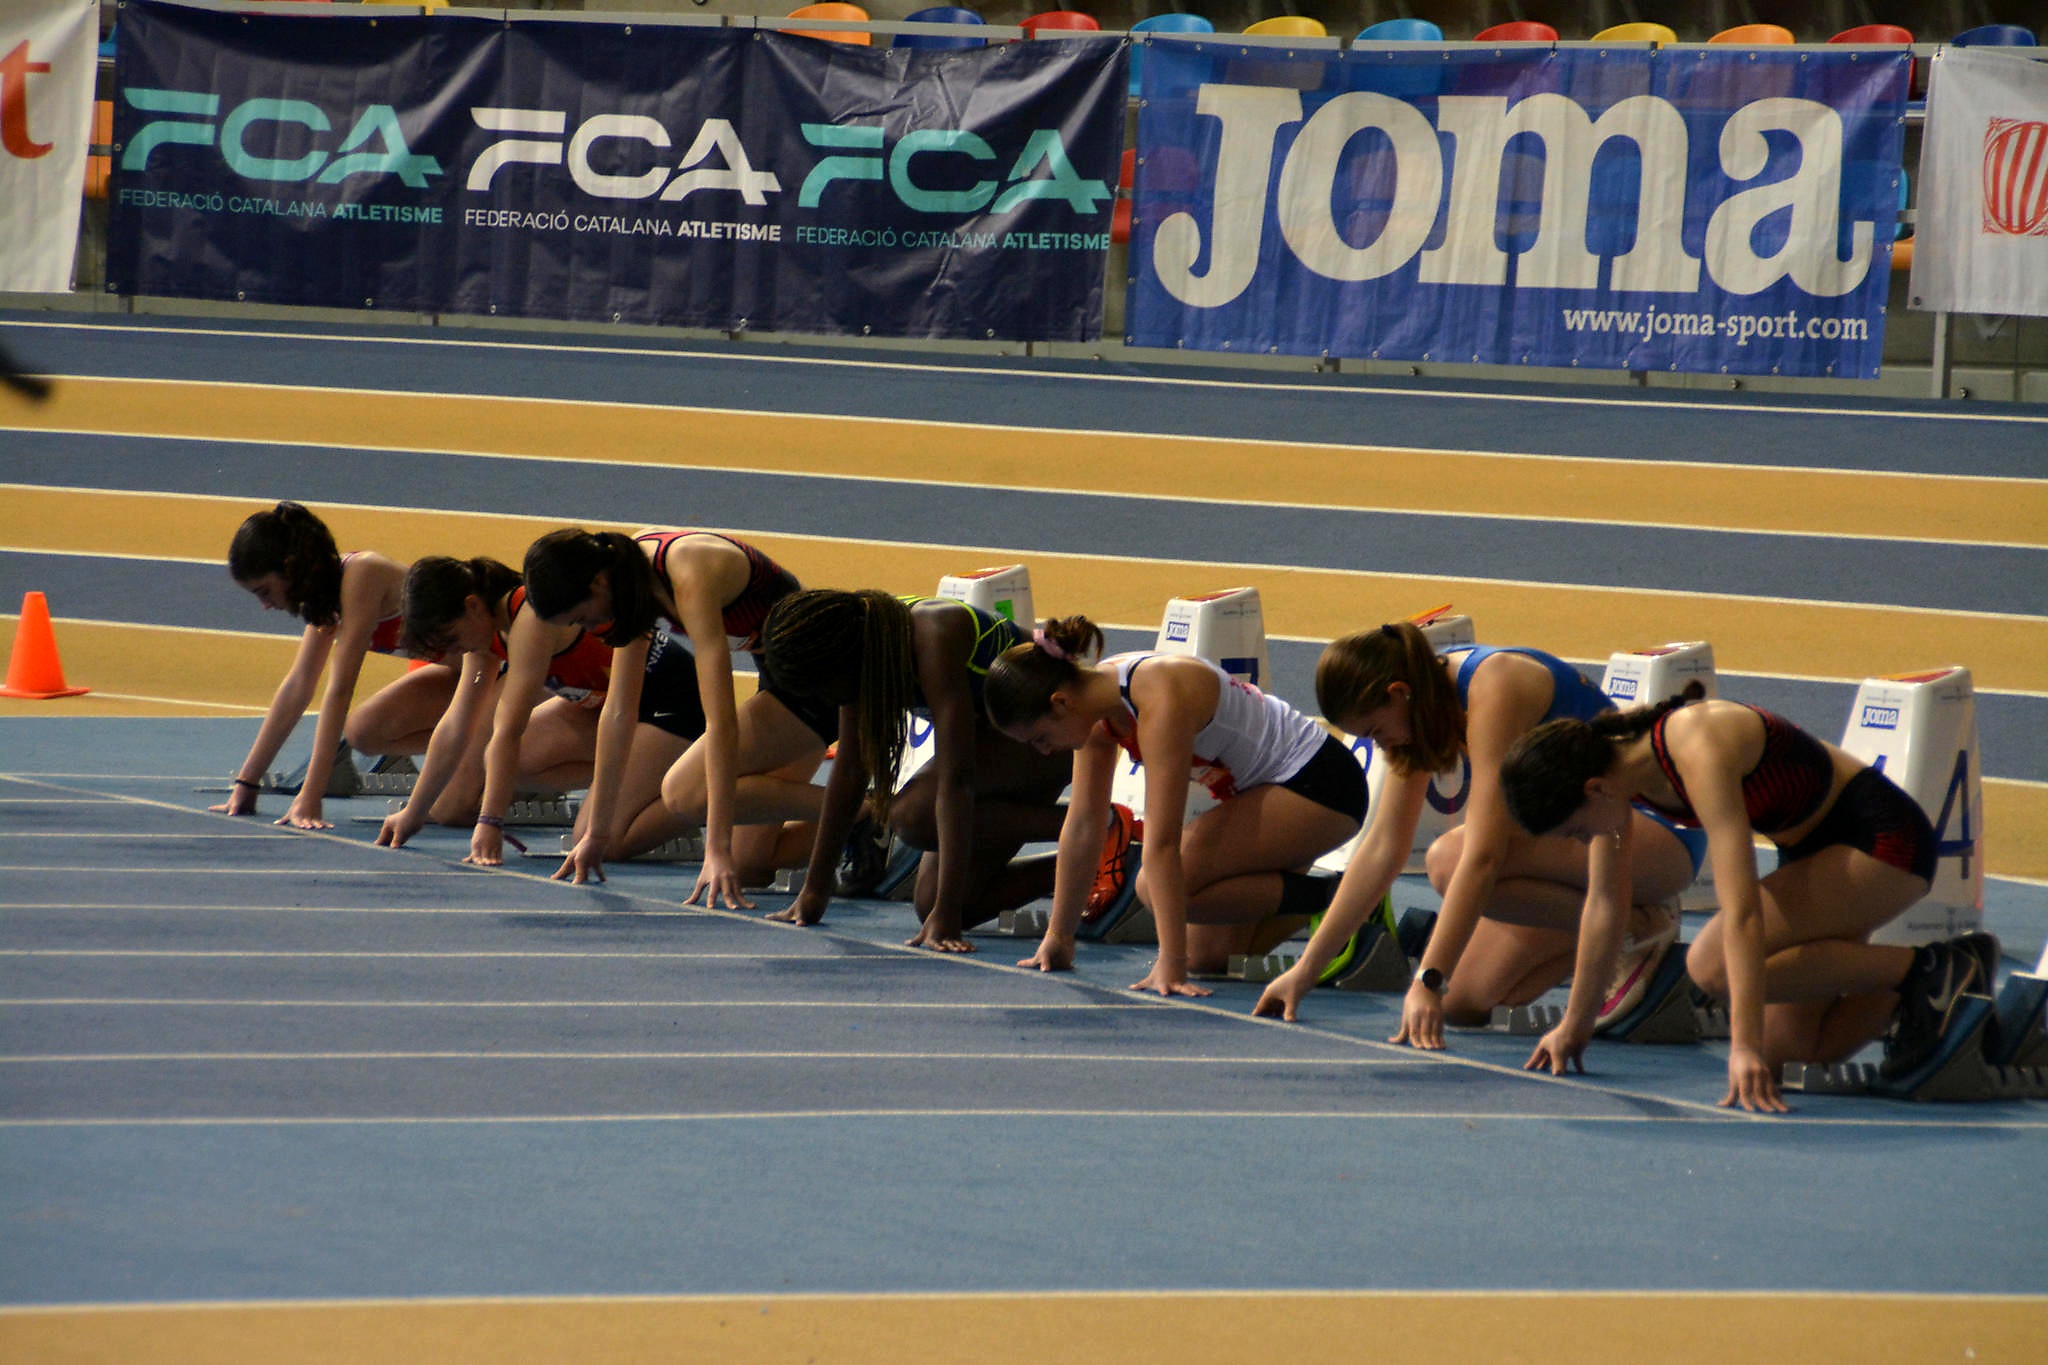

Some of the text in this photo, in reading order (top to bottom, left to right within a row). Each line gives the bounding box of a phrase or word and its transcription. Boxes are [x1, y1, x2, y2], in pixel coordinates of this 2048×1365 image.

[121, 87, 444, 188] FCA
[466, 107, 782, 206] FCA
[797, 123, 1112, 214] FCA
[119, 188, 443, 223] FEDERACIÓ CATALANA ATLETISME
[464, 208, 781, 242] FEDERACIÓ CATALANA ATLETISME
[796, 226, 1110, 250] FEDERACIÓ CATALANA ATLETISME
[1563, 304, 1868, 346] www.joma-sport.com
[1934, 750, 1975, 879] 4
